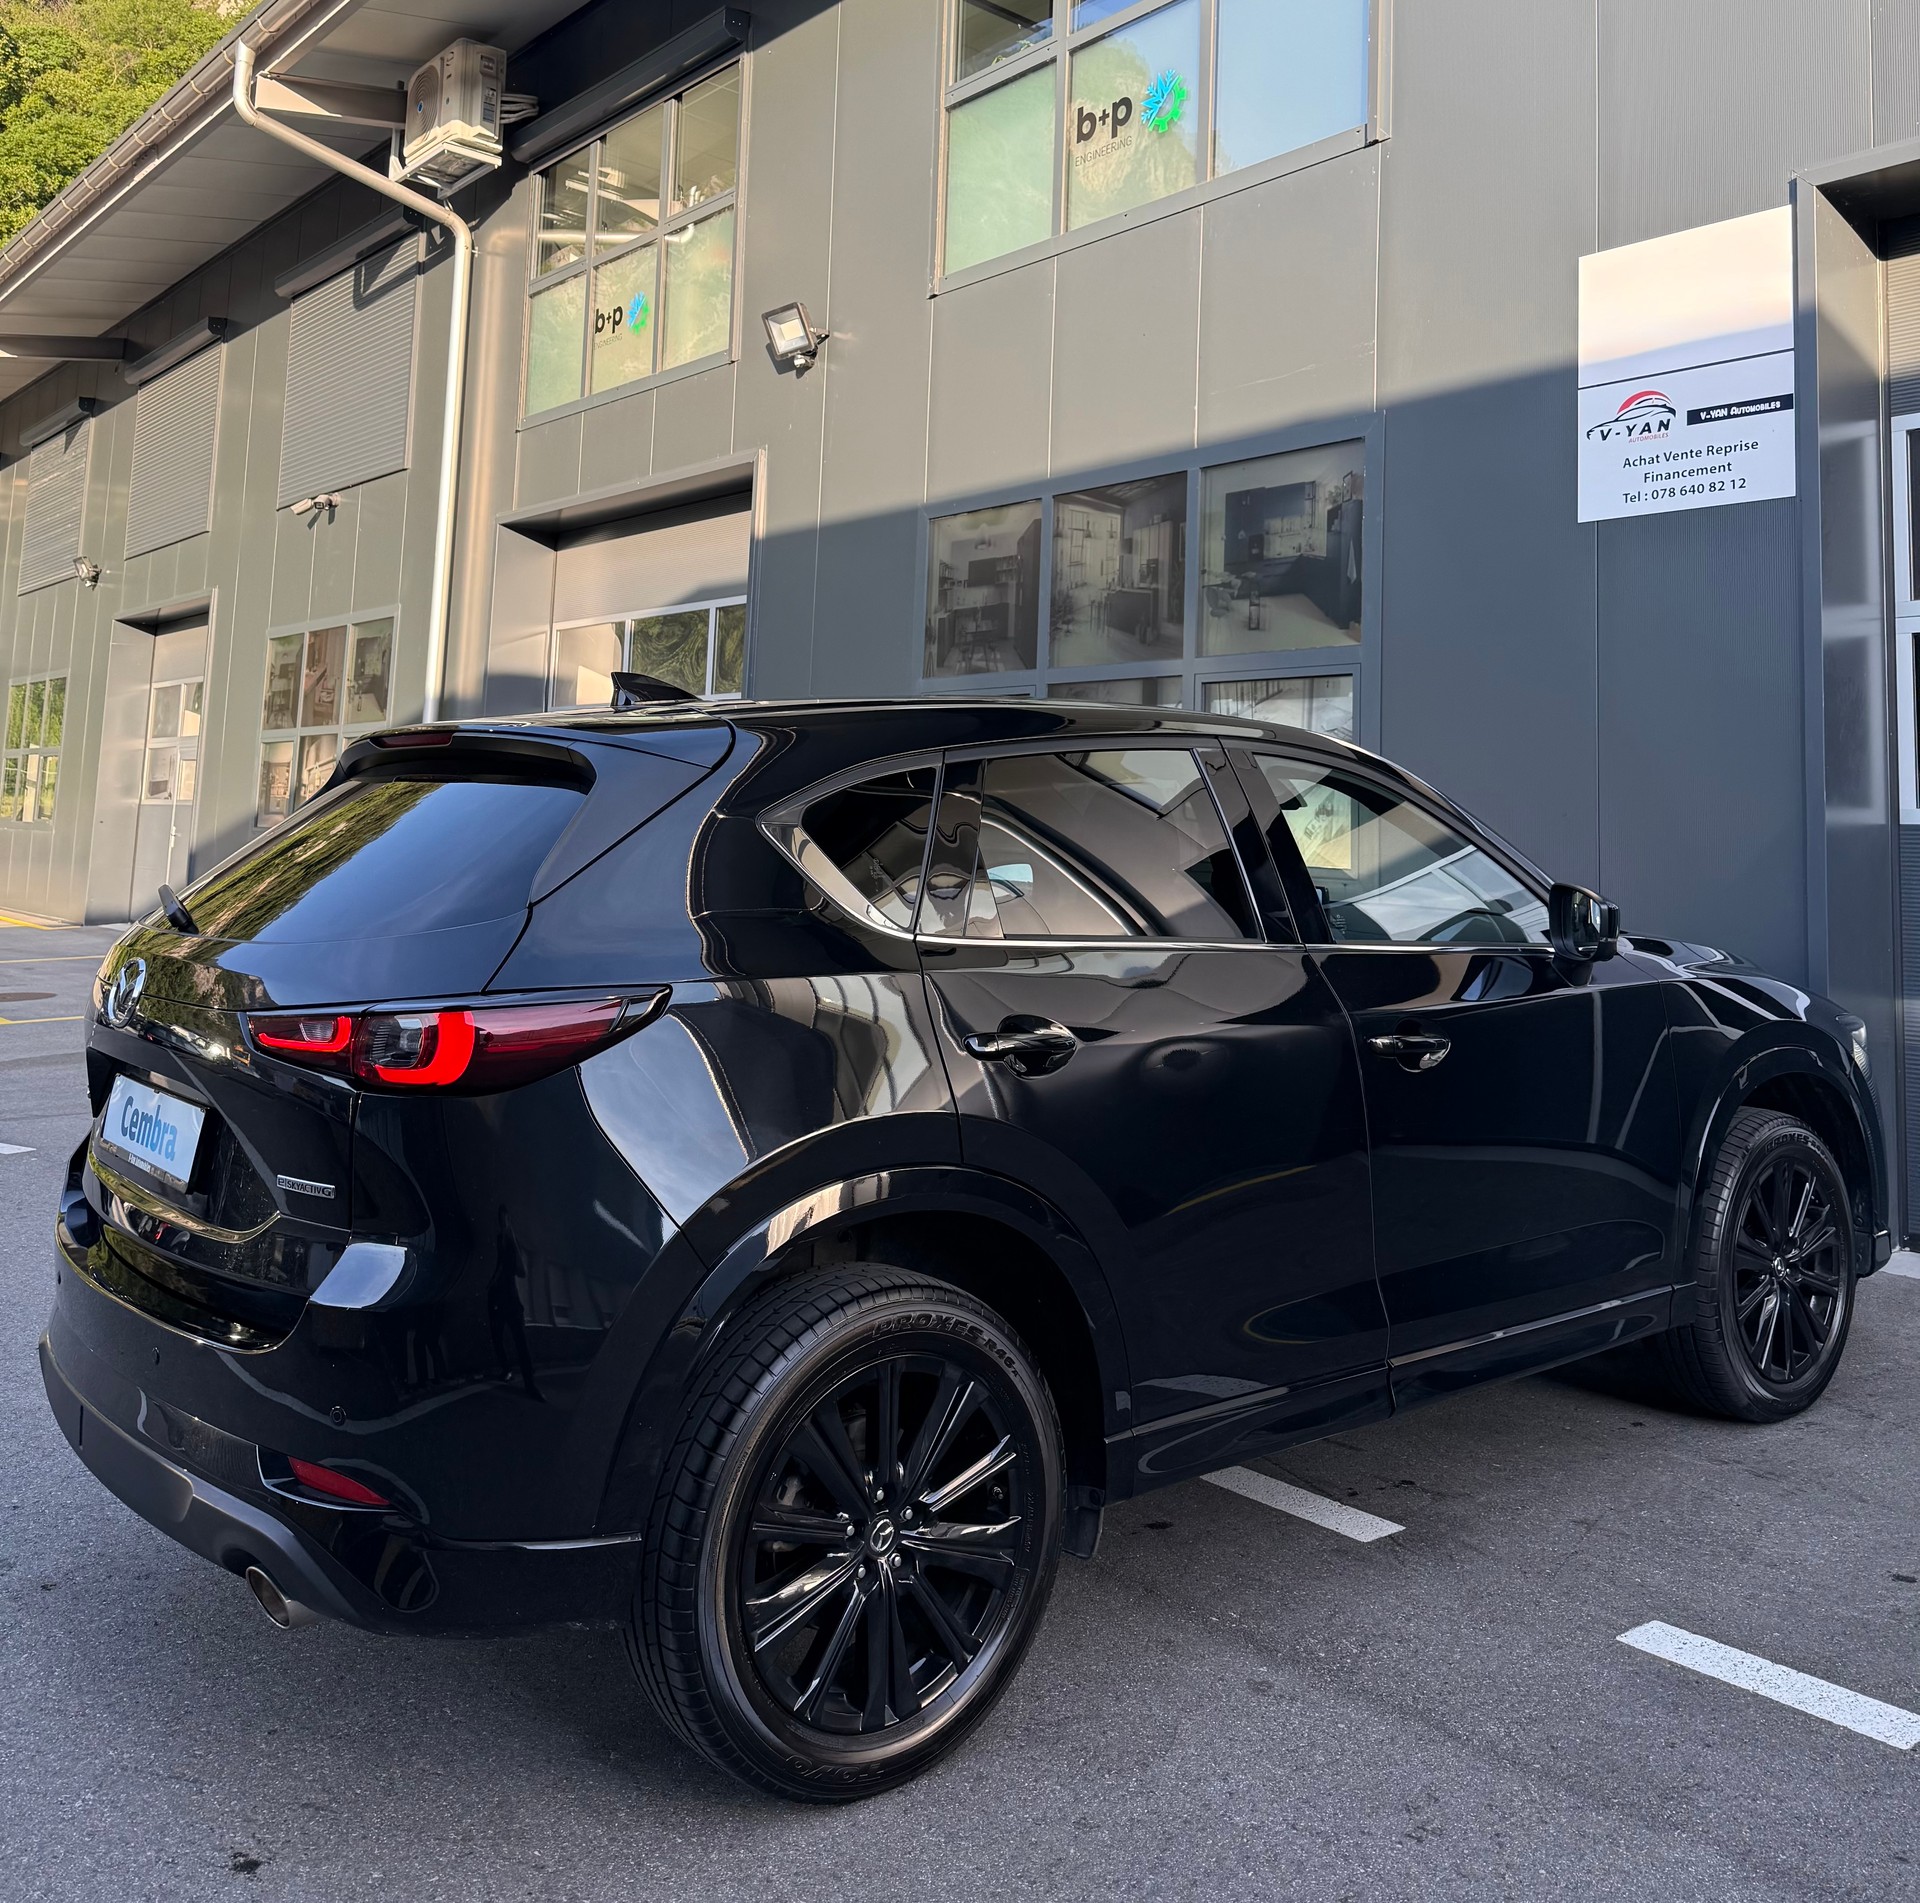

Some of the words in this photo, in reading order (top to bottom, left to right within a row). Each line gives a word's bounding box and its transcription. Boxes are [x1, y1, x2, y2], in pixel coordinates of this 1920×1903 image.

[1076, 96, 1133, 144] b+p
[1074, 136, 1133, 167] ENGINEERING
[595, 305, 623, 334] b+p
[1700, 407, 1728, 421] V-YAN
[1628, 432, 1669, 444] AUTOMOBILES
[1622, 454, 1660, 469] Achat
[1663, 447, 1703, 462] Vente
[1706, 440, 1759, 457] Reprise
[1643, 462, 1733, 484] Financement
[1651, 486, 1676, 500] 078
[1679, 483, 1705, 497] 640
[1708, 480, 1726, 493] 82
[1731, 477, 1747, 490] 12
[121, 1096, 178, 1162] Cembra
